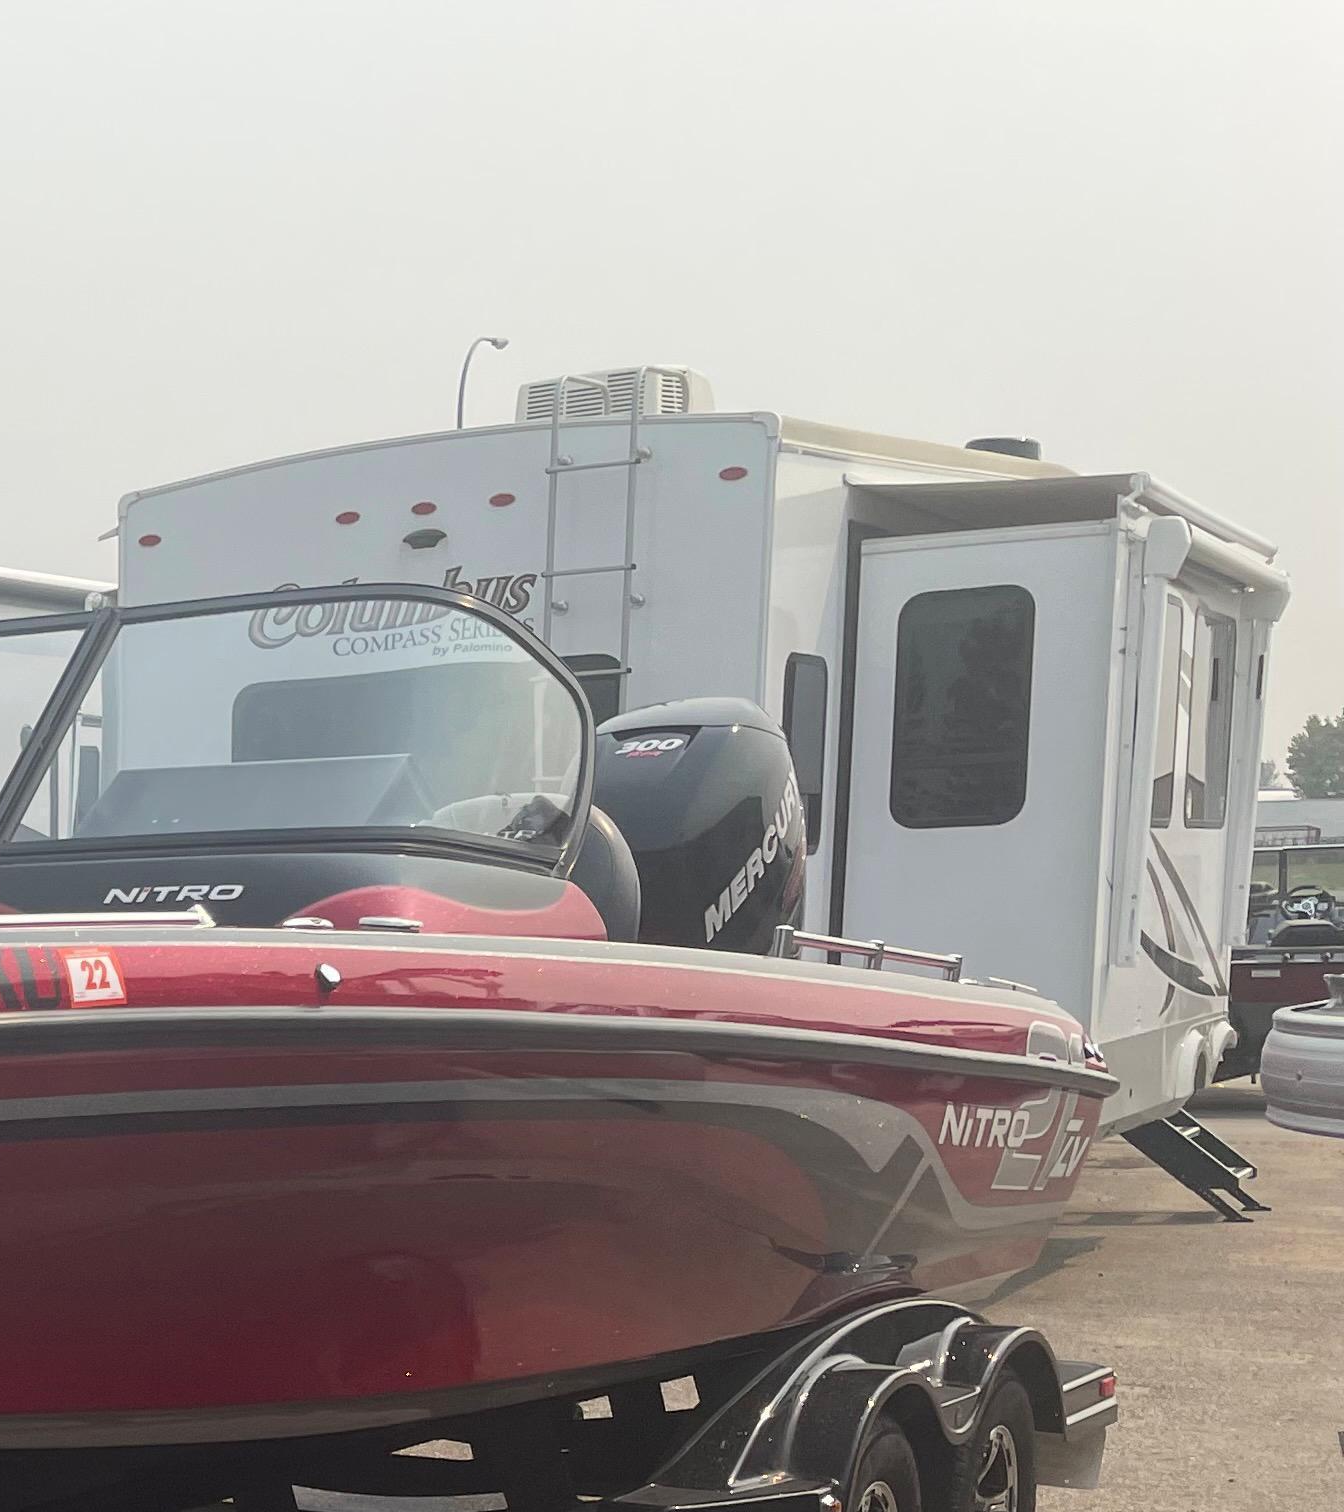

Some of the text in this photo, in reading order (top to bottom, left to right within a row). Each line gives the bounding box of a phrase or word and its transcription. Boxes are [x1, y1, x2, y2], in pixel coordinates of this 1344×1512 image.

[333, 617, 535, 656] COMPASS SERIS
[432, 642, 513, 656] by Palomino
[80, 959, 111, 990] 22
